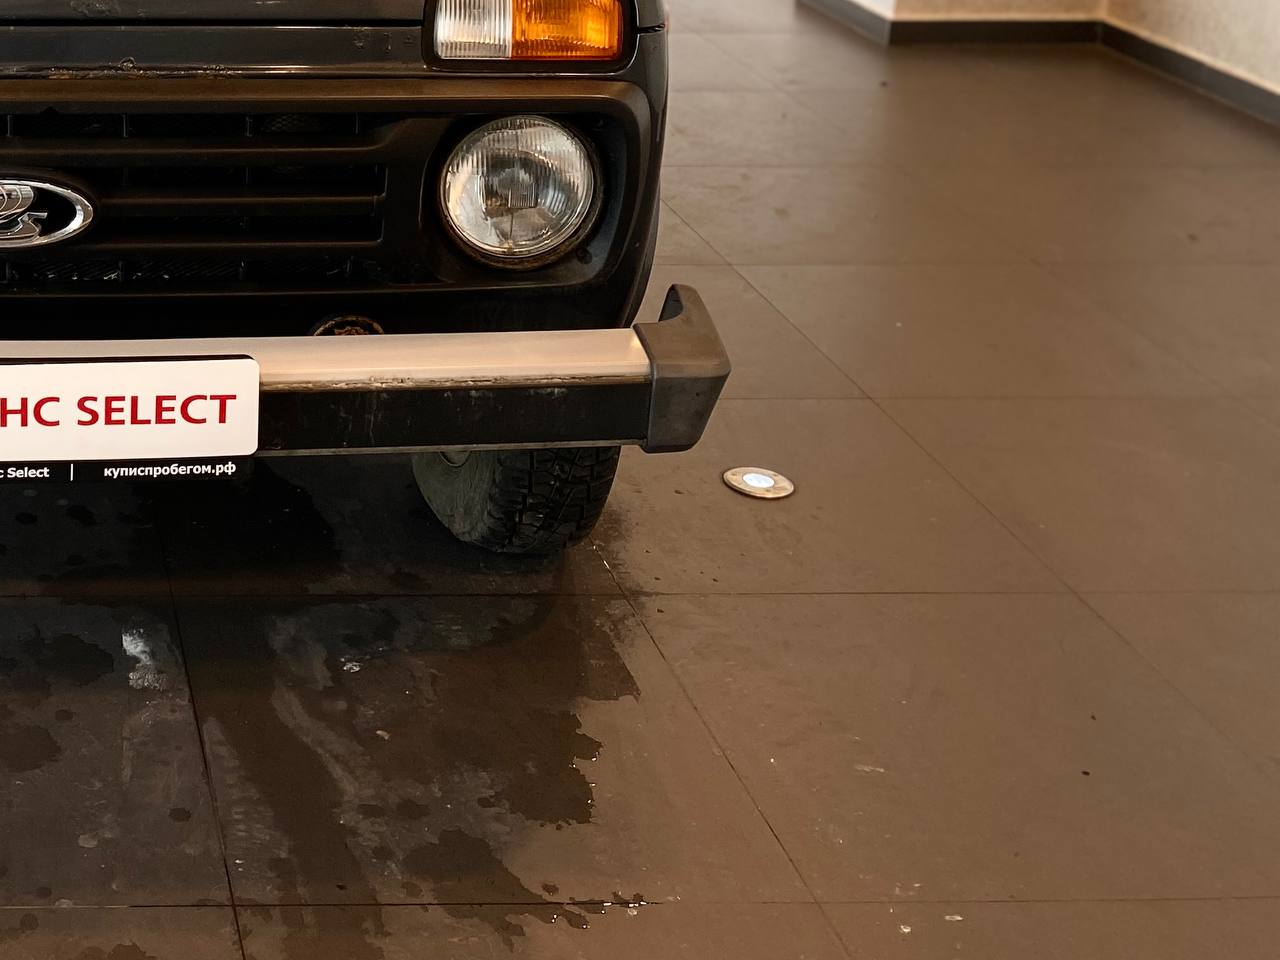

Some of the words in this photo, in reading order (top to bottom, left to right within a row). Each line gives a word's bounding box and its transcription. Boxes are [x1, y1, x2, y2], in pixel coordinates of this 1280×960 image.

[76, 393, 238, 427] SELECT
[6, 466, 50, 478] Select
[103, 461, 237, 479] куписпробегом.рф
